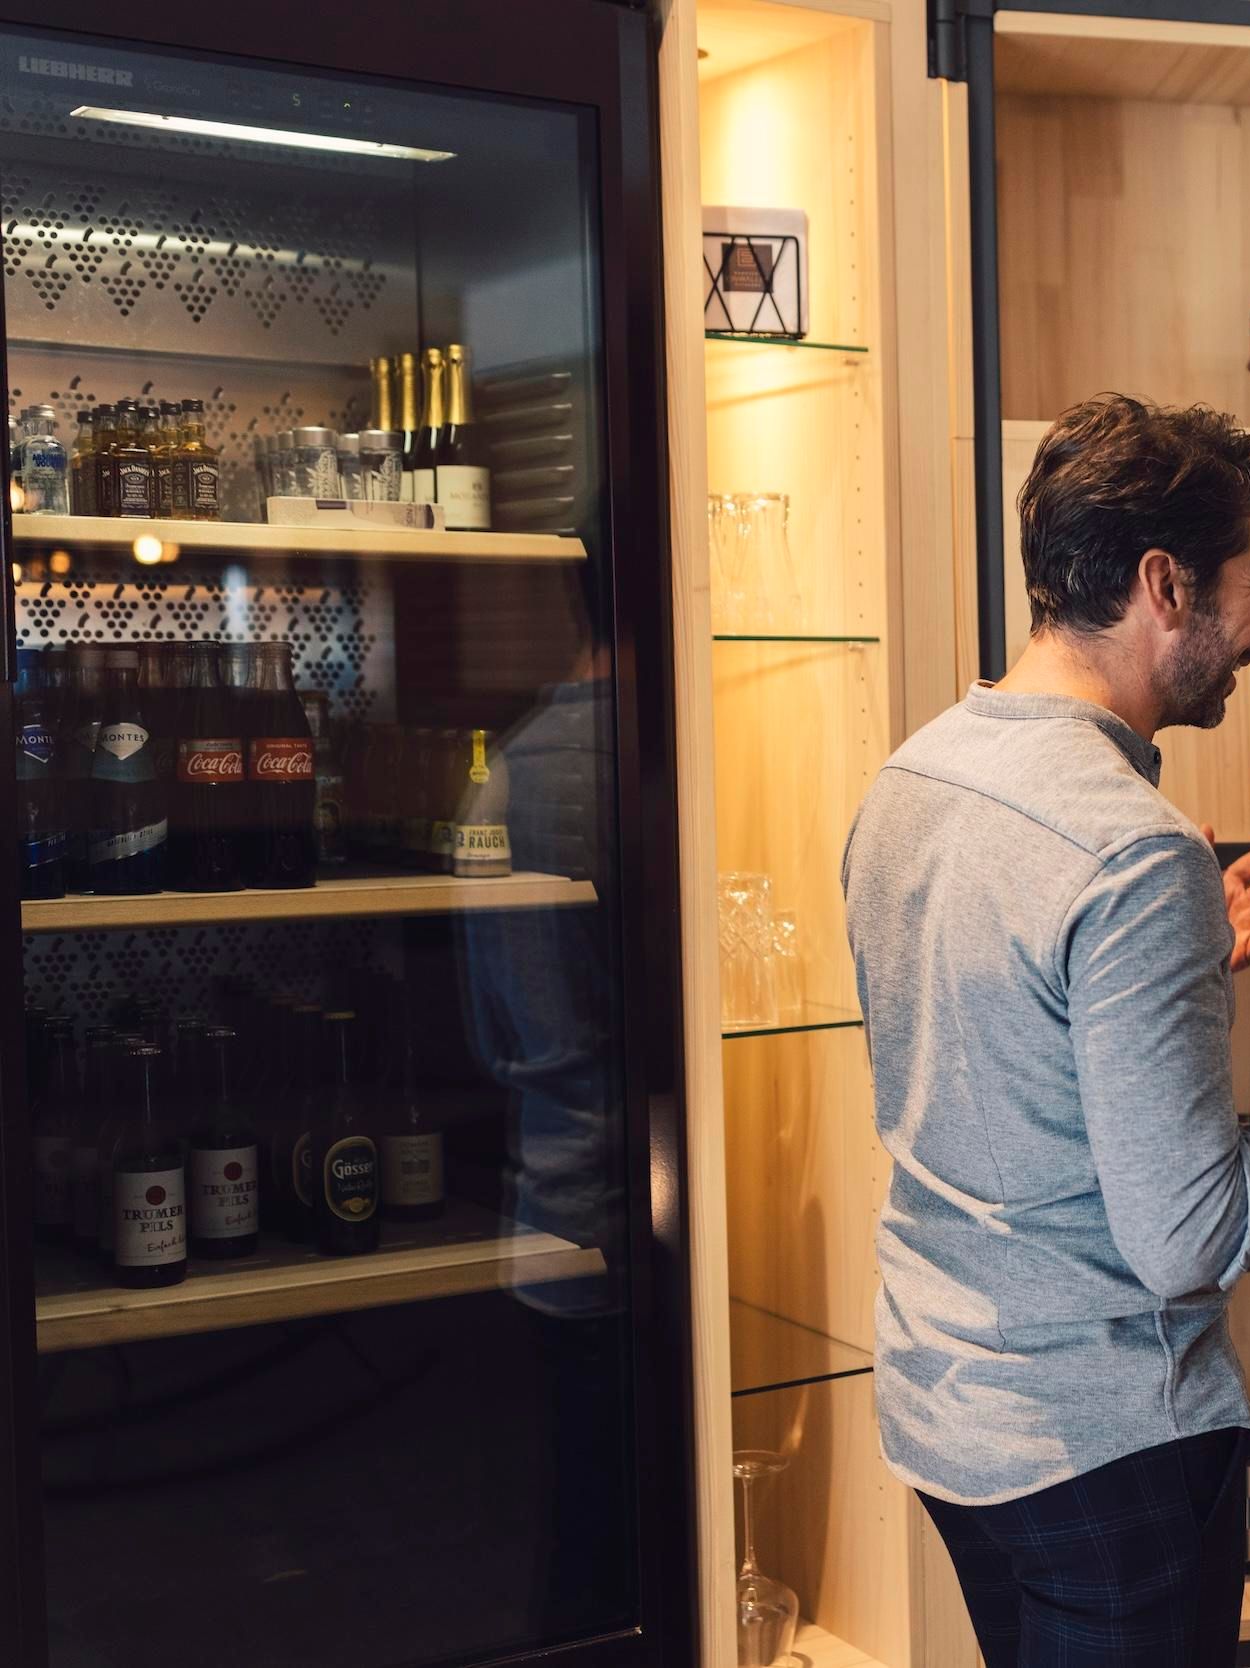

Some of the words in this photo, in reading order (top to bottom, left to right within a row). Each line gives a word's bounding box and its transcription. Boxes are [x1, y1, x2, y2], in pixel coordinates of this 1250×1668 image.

[19, 55, 134, 88] LIEBHERR
[102, 733, 145, 743] MONTES
[256, 751, 312, 776] Coca-Cola
[469, 836, 505, 849] RAUCH
[122, 1204, 185, 1221] TRUMER
[139, 1220, 174, 1233] PILS
